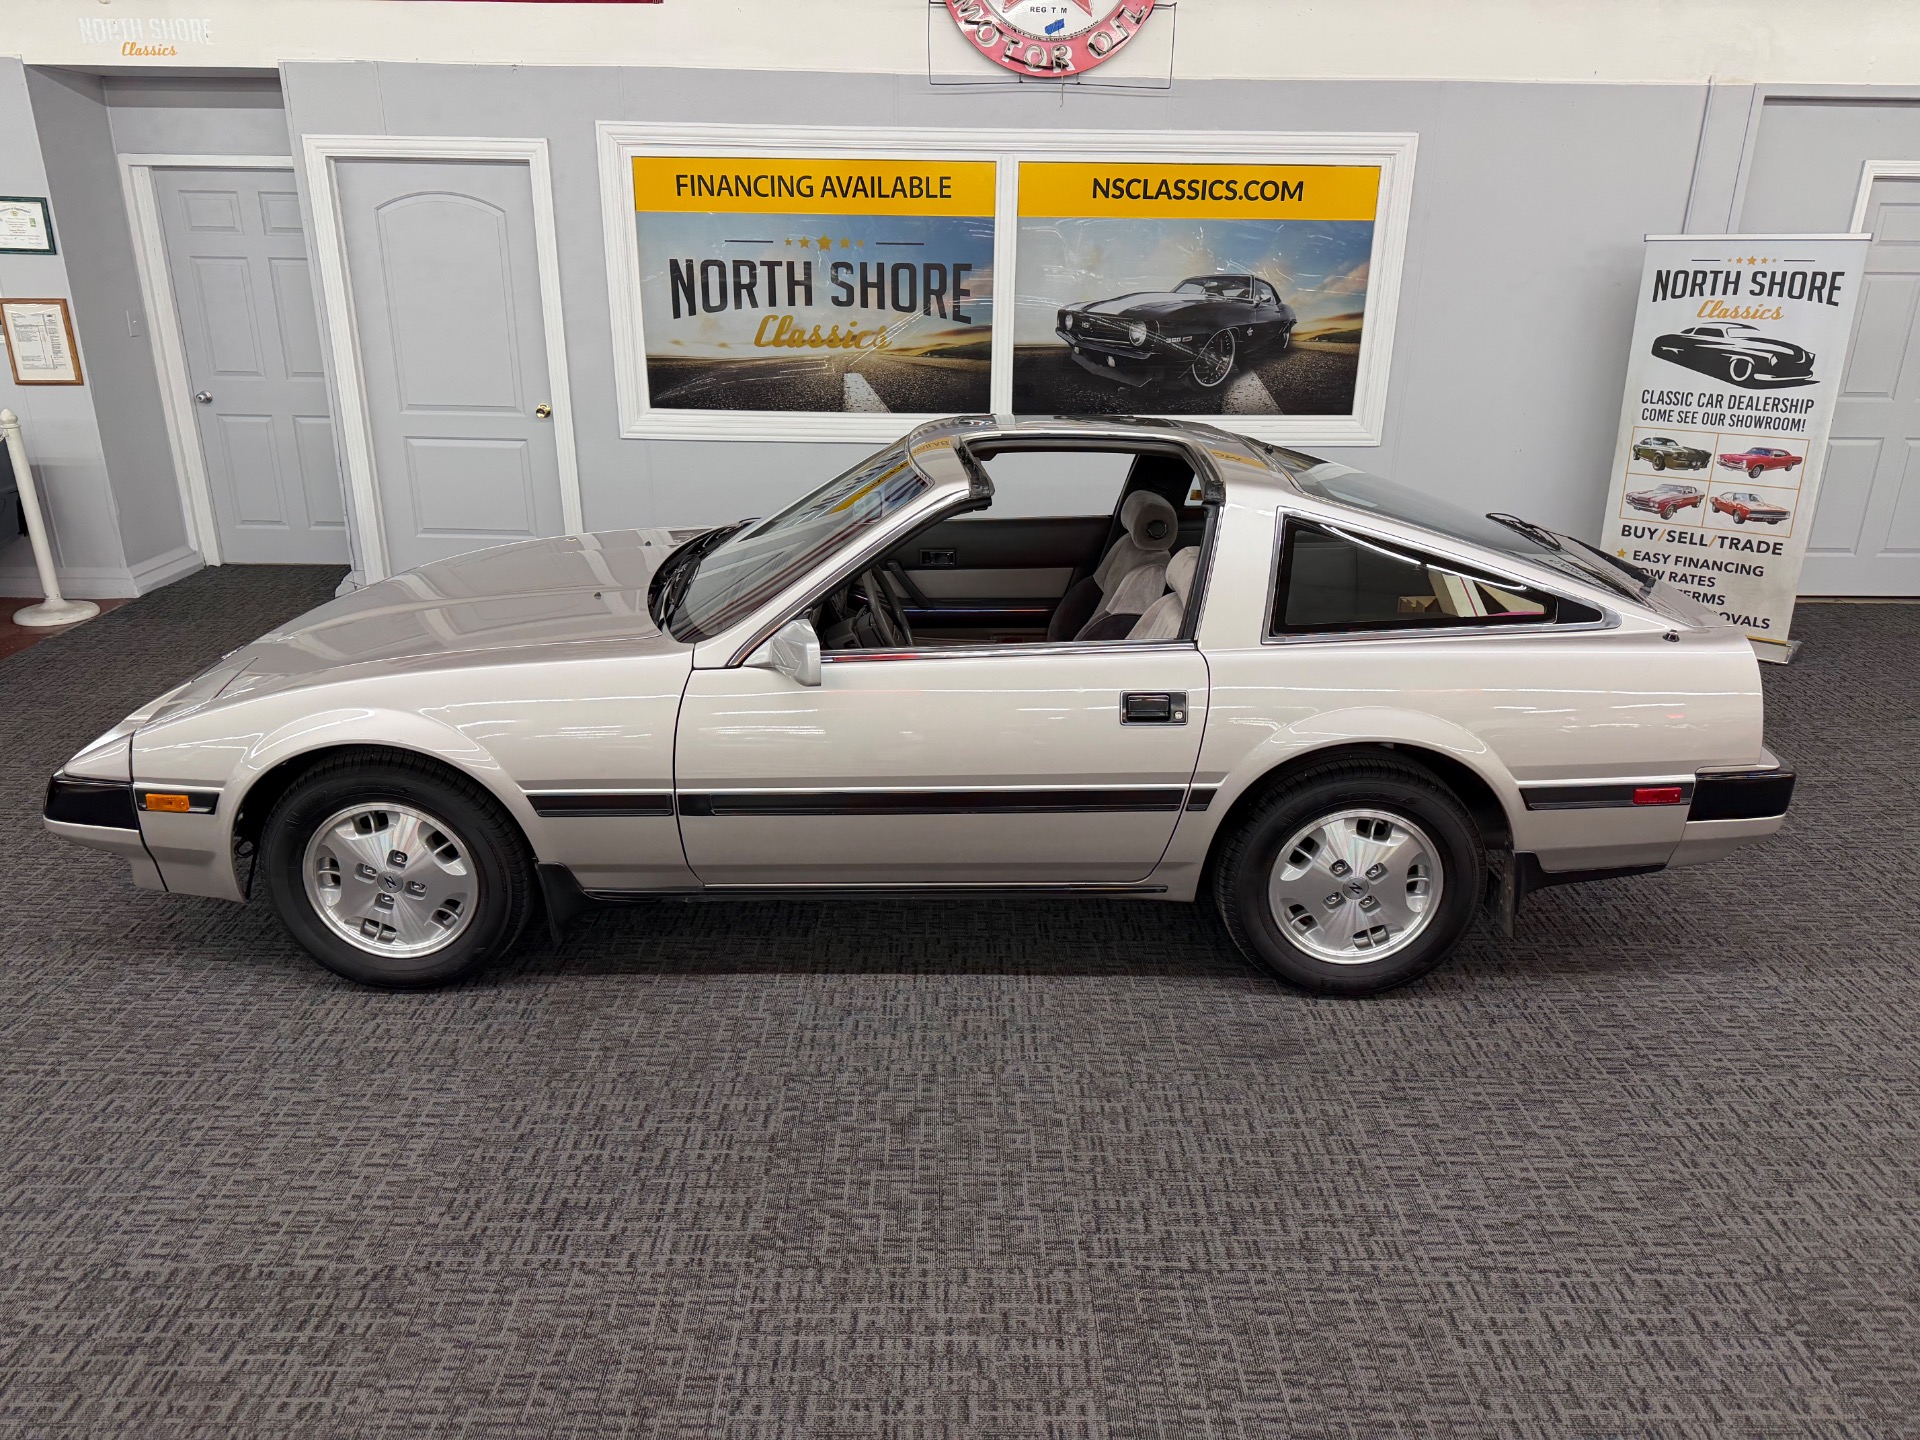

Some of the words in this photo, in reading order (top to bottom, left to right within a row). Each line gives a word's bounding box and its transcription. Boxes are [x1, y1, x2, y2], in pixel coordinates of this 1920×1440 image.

[78, 17, 144, 44] NORTH
[149, 18, 214, 46] SHORE
[952, 0, 1076, 73] MOTOR
[1087, 5, 1148, 59] OIL
[121, 41, 177, 57] Classics
[675, 174, 814, 198] FINANCING
[820, 175, 952, 199] AVAILABLE
[1092, 177, 1304, 201] NSCLASSICS.COM
[669, 258, 813, 319] NORTH
[830, 261, 973, 325] SHORE
[1652, 269, 1742, 303] NORTH
[1749, 270, 1846, 307] SHORE
[1696, 299, 1785, 321] Classics
[753, 314, 893, 350] Classics
[1641, 389, 1694, 407] CLASSIC
[1697, 392, 1723, 409] CAR
[1727, 394, 1815, 415] DEALERSHIP
[1641, 407, 1675, 424] COME
[1676, 410, 1699, 425] SEE
[1701, 411, 1726, 427] OUR
[1728, 413, 1807, 432] SHOWROOM!
[1632, 550, 1671, 565] EASY
[1674, 555, 1765, 577] FINANCING
[1668, 571, 1717, 588] RATES
